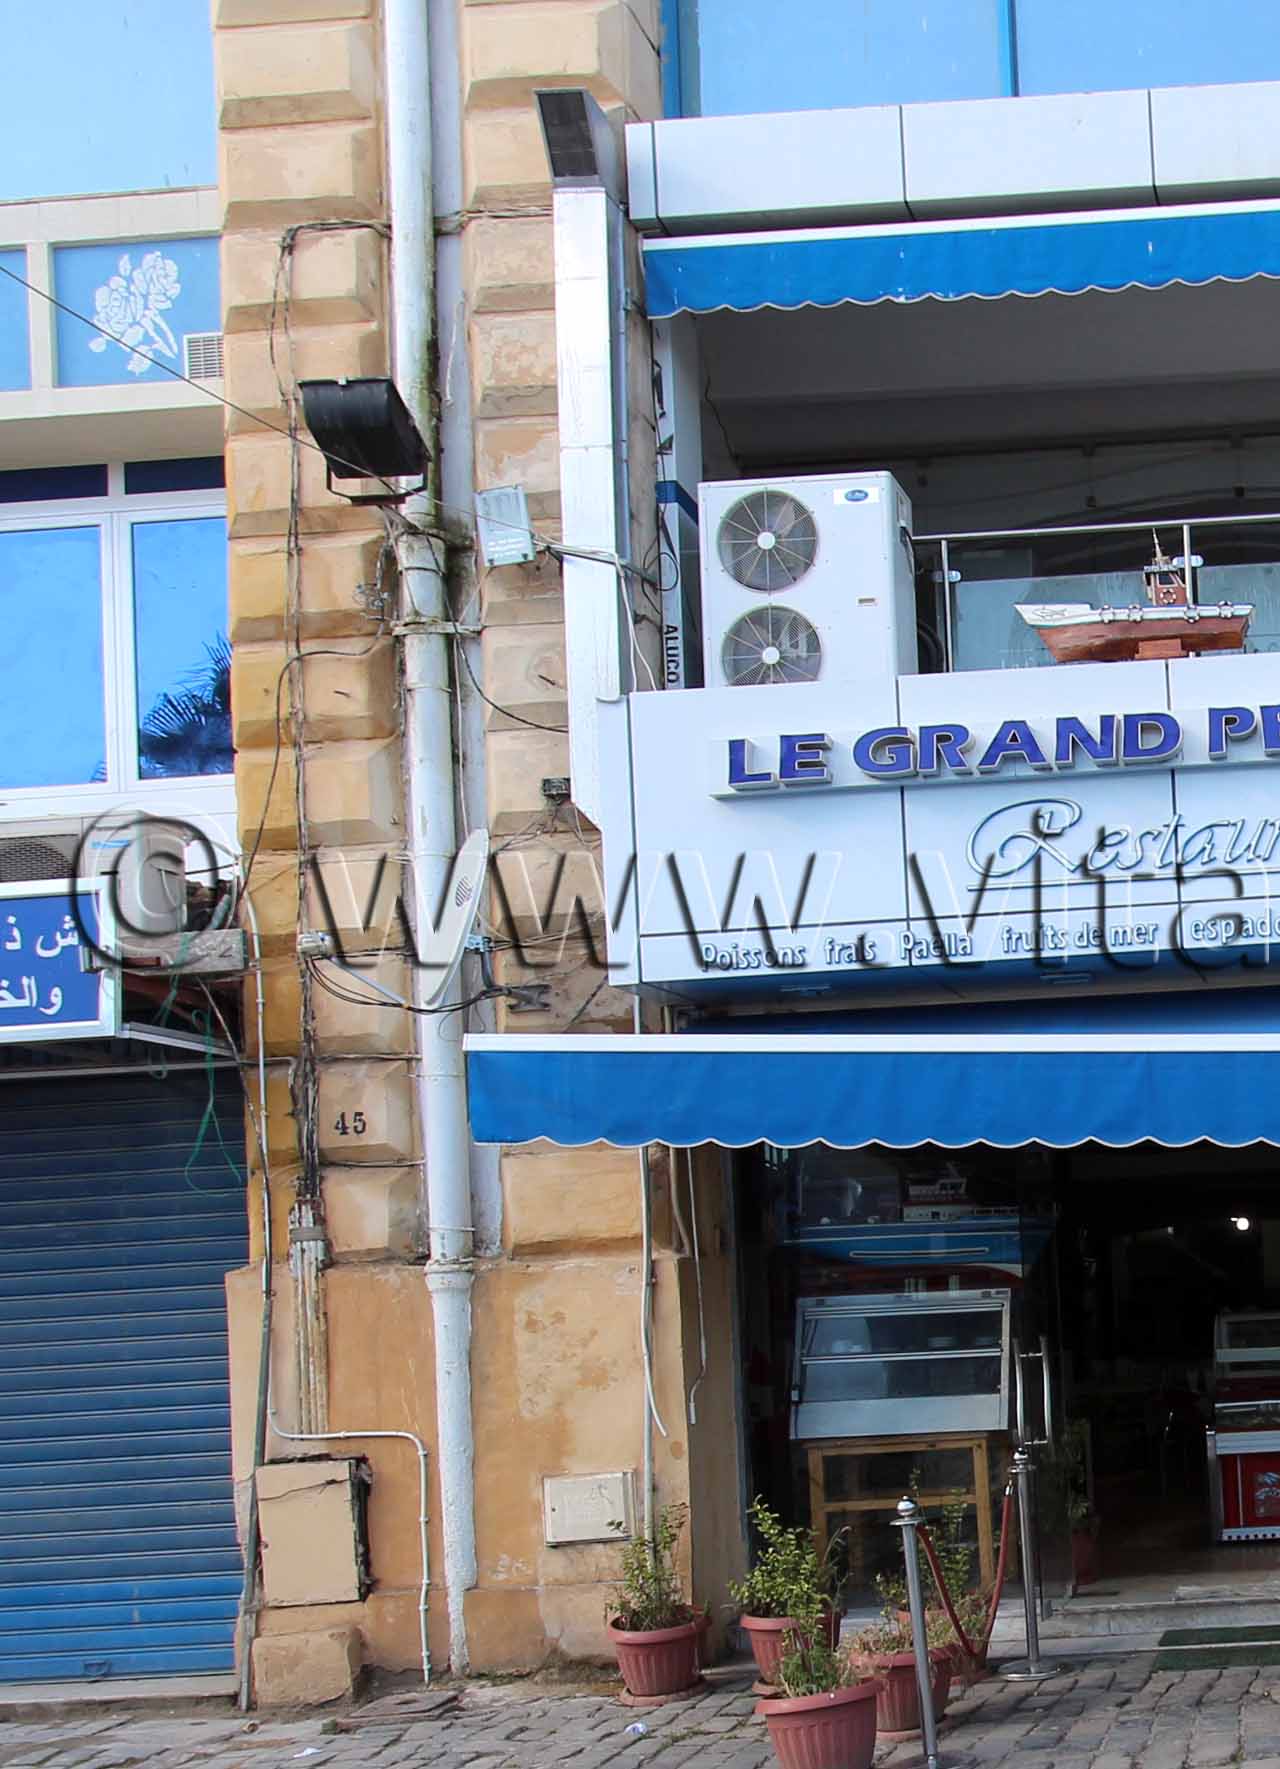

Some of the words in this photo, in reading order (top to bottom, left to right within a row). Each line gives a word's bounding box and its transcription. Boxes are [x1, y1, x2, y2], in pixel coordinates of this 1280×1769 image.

[663, 624, 681, 684] ALUCO
[727, 732, 833, 791] LE
[852, 711, 1188, 779] GRAND
[700, 942, 806, 973] Poissons
[823, 931, 878, 965] frais
[898, 929, 974, 961] Paella
[1001, 922, 1067, 954] fruits
[1073, 919, 1103, 948] de
[1109, 921, 1160, 947] mer
[333, 1111, 367, 1135] 45
